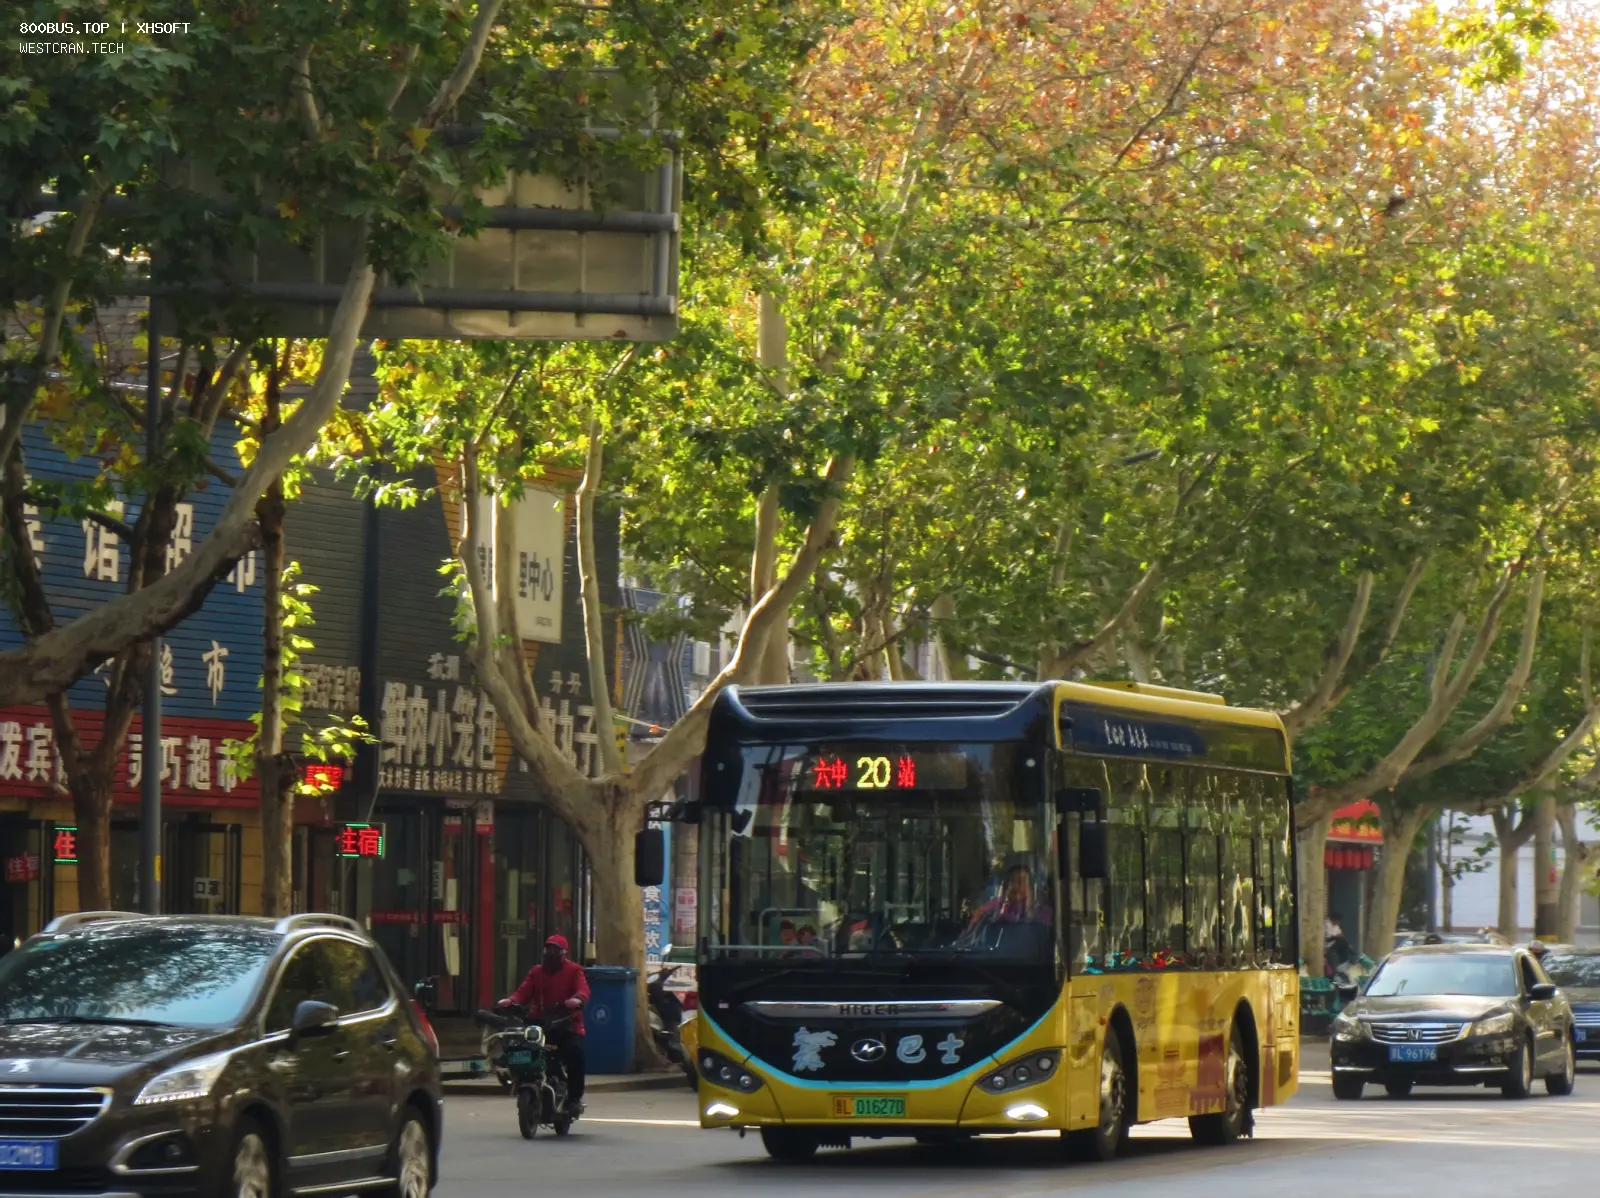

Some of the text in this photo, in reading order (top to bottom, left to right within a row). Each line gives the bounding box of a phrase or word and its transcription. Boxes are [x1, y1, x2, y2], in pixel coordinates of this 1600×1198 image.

[380, 681, 498, 770] 鲜肉小笼包
[813, 757, 847, 788] 六中
[857, 756, 891, 788] 20
[194, 880, 221, 896] 口罩
